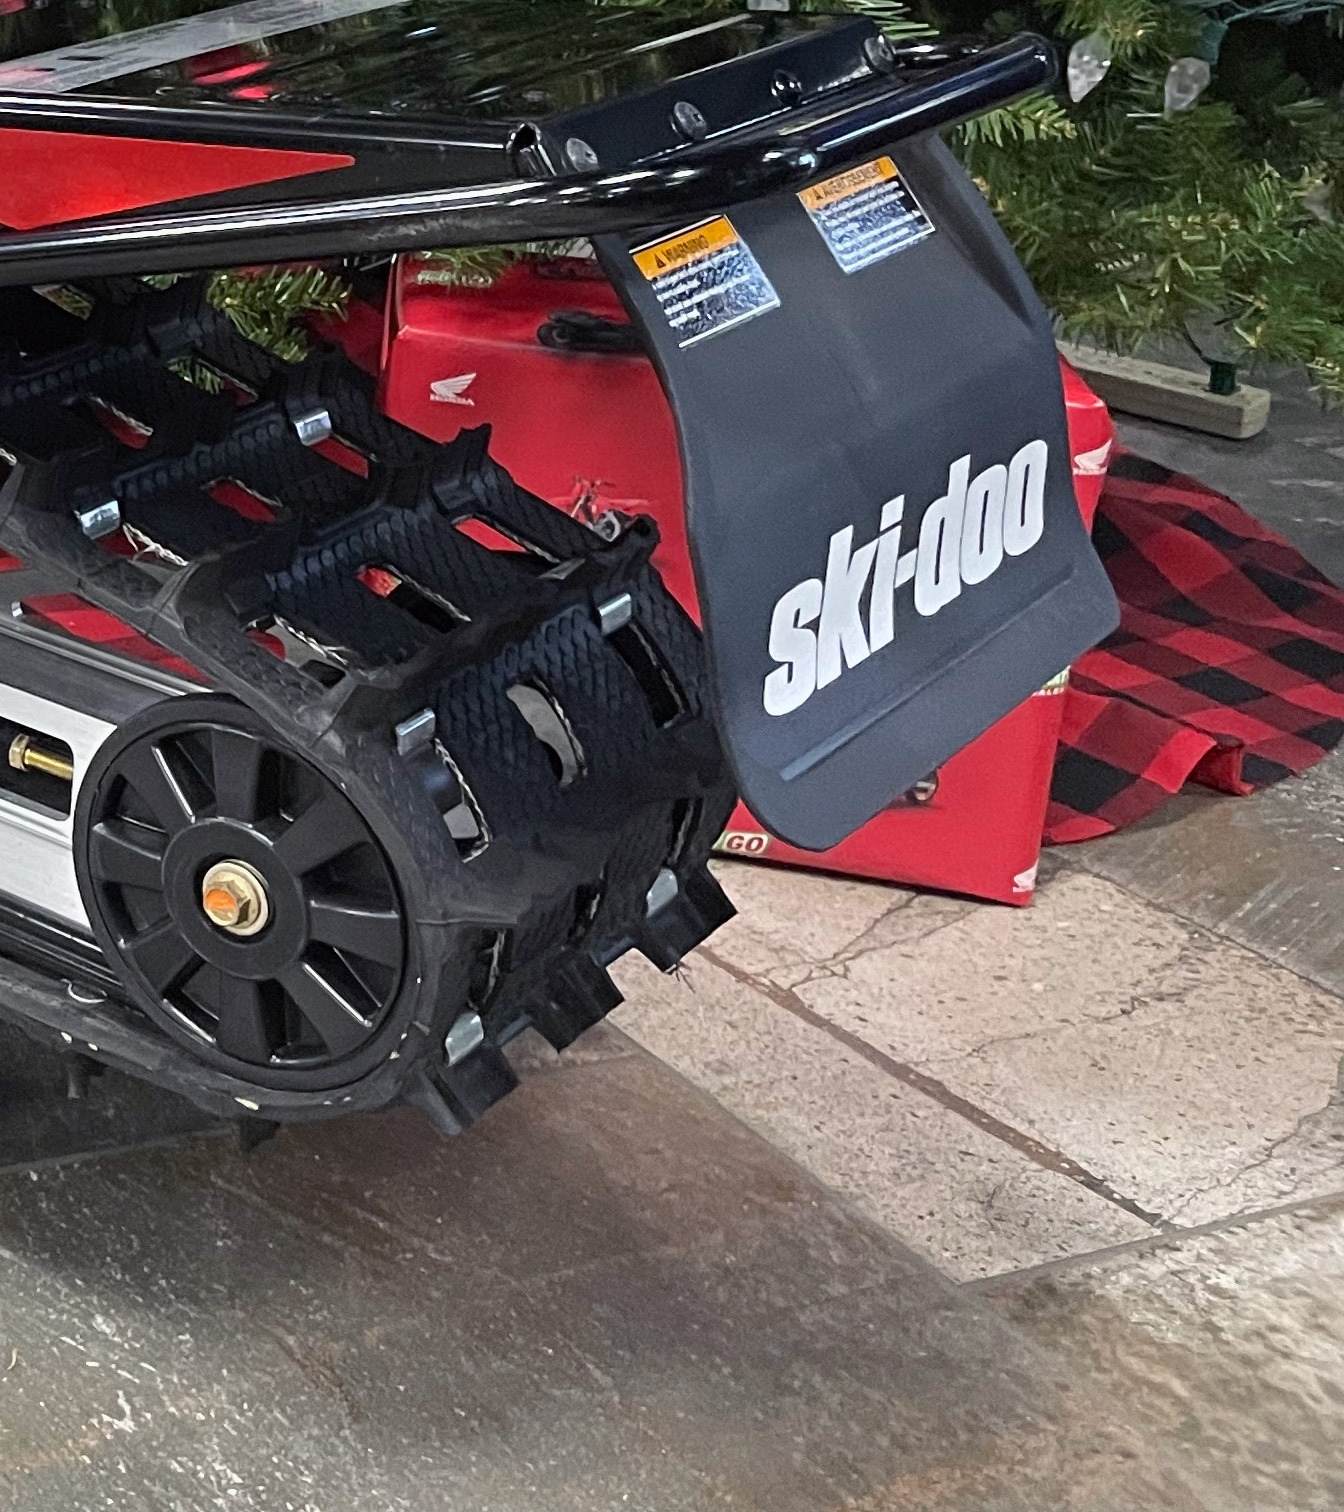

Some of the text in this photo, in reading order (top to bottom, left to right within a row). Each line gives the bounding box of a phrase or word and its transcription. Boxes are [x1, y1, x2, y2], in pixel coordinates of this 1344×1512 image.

[662, 234, 709, 263] WARNING
[763, 439, 1048, 717] ski-doo
[726, 835, 764, 853] GO
